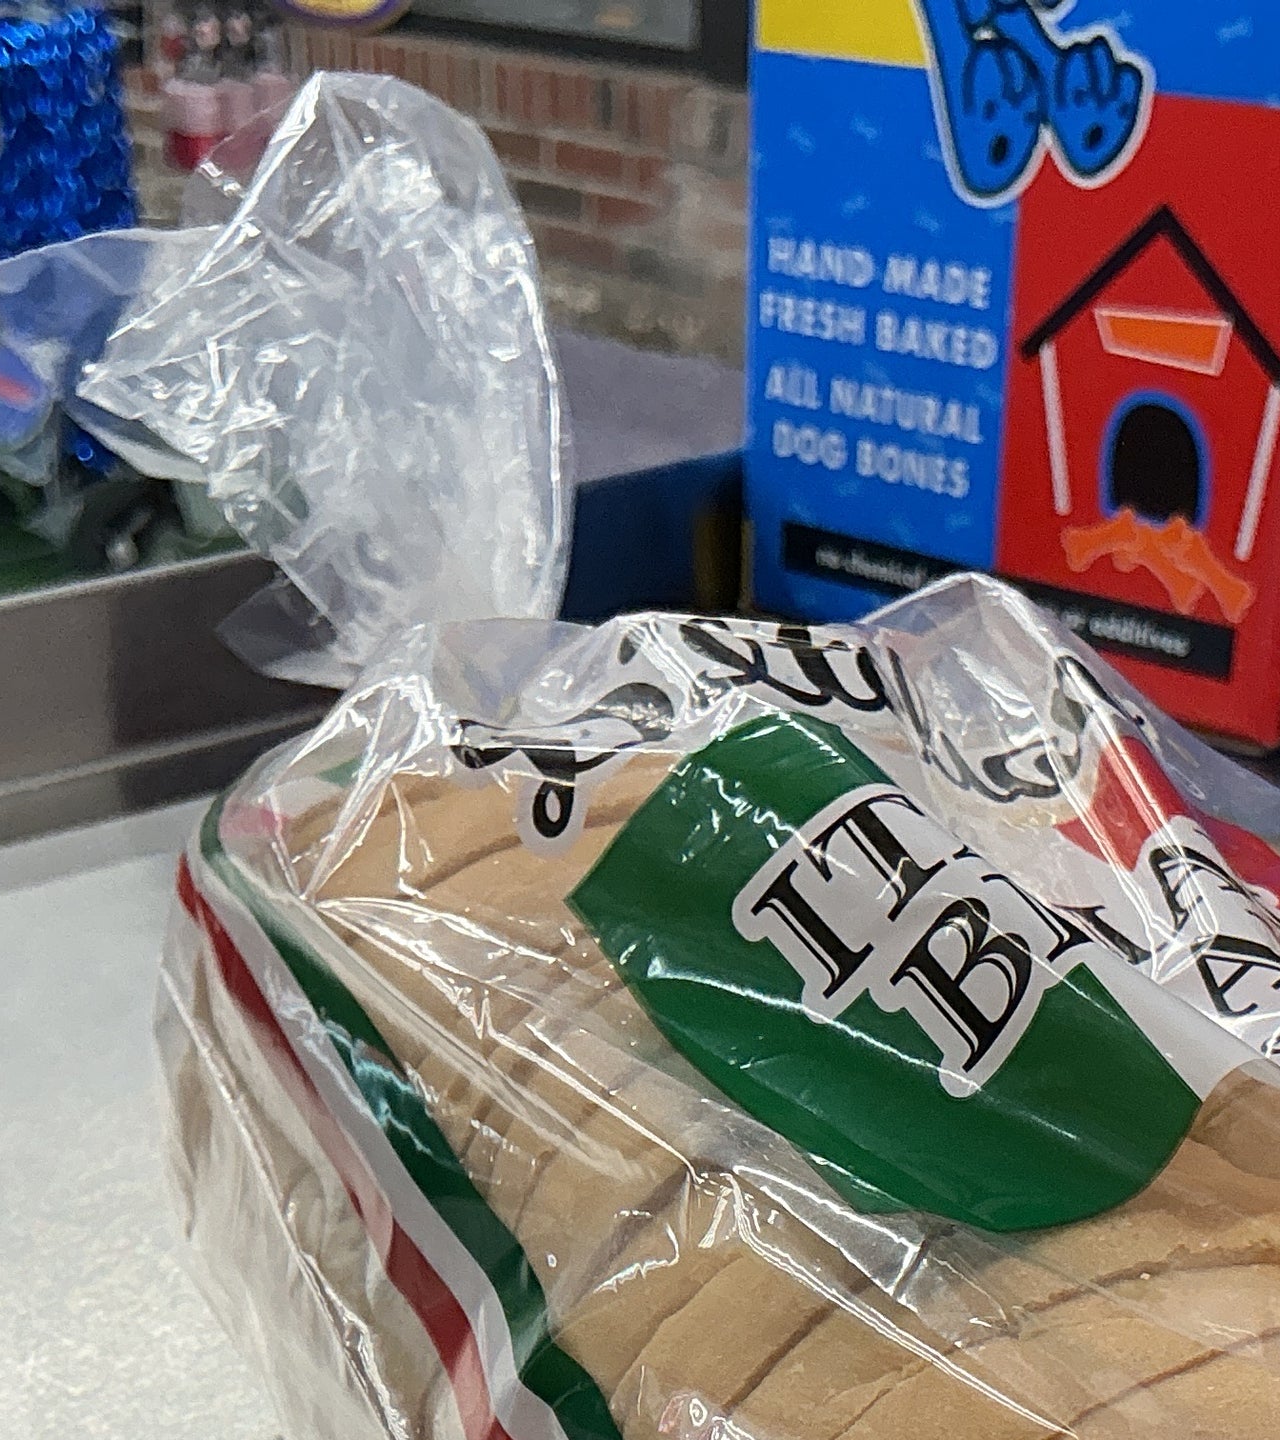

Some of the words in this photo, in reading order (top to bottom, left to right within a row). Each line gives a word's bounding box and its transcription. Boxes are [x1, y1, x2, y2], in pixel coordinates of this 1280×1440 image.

[767, 237, 875, 288] HAND
[882, 253, 992, 310] MADE
[759, 290, 867, 345] FRESH
[875, 310, 999, 370] BAKED
[764, 365, 822, 410] ALL
[830, 375, 983, 445] NATURAL
[772, 418, 848, 470] DOG
[856, 438, 970, 498] BONES
